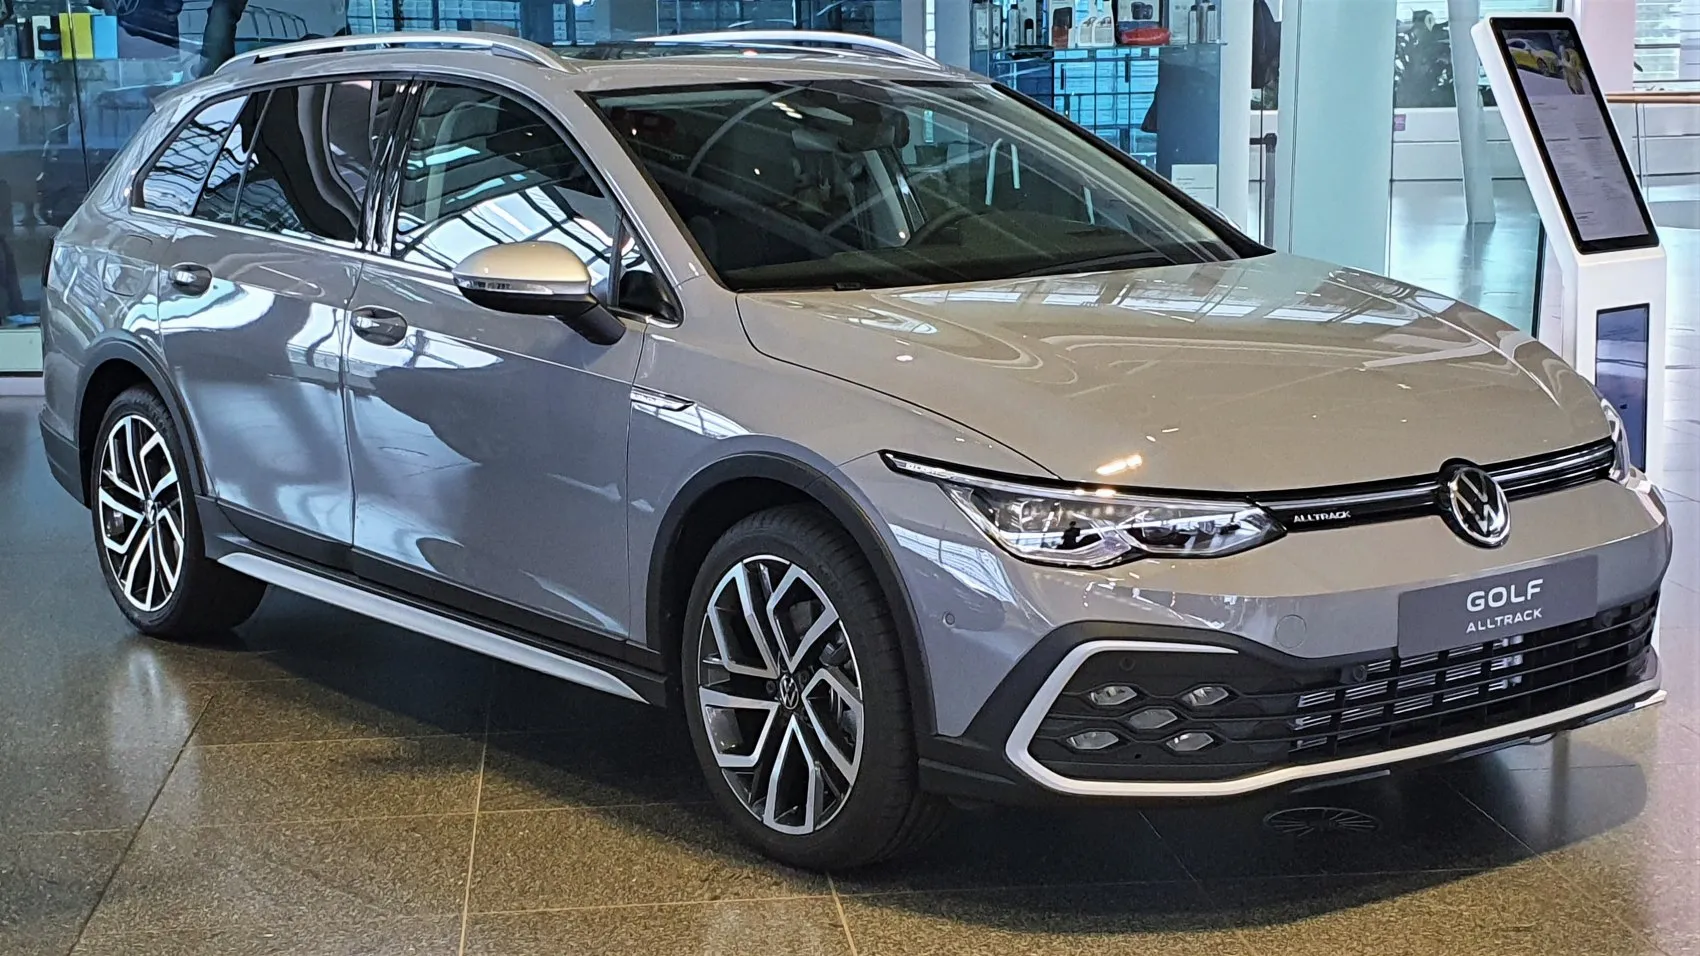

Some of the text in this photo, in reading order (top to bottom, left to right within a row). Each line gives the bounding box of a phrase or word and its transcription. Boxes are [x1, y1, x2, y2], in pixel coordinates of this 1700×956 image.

[1294, 510, 1351, 523] ALLTRACK
[1466, 578, 1544, 612] GOLF
[1466, 607, 1542, 633] ALLTRACK
